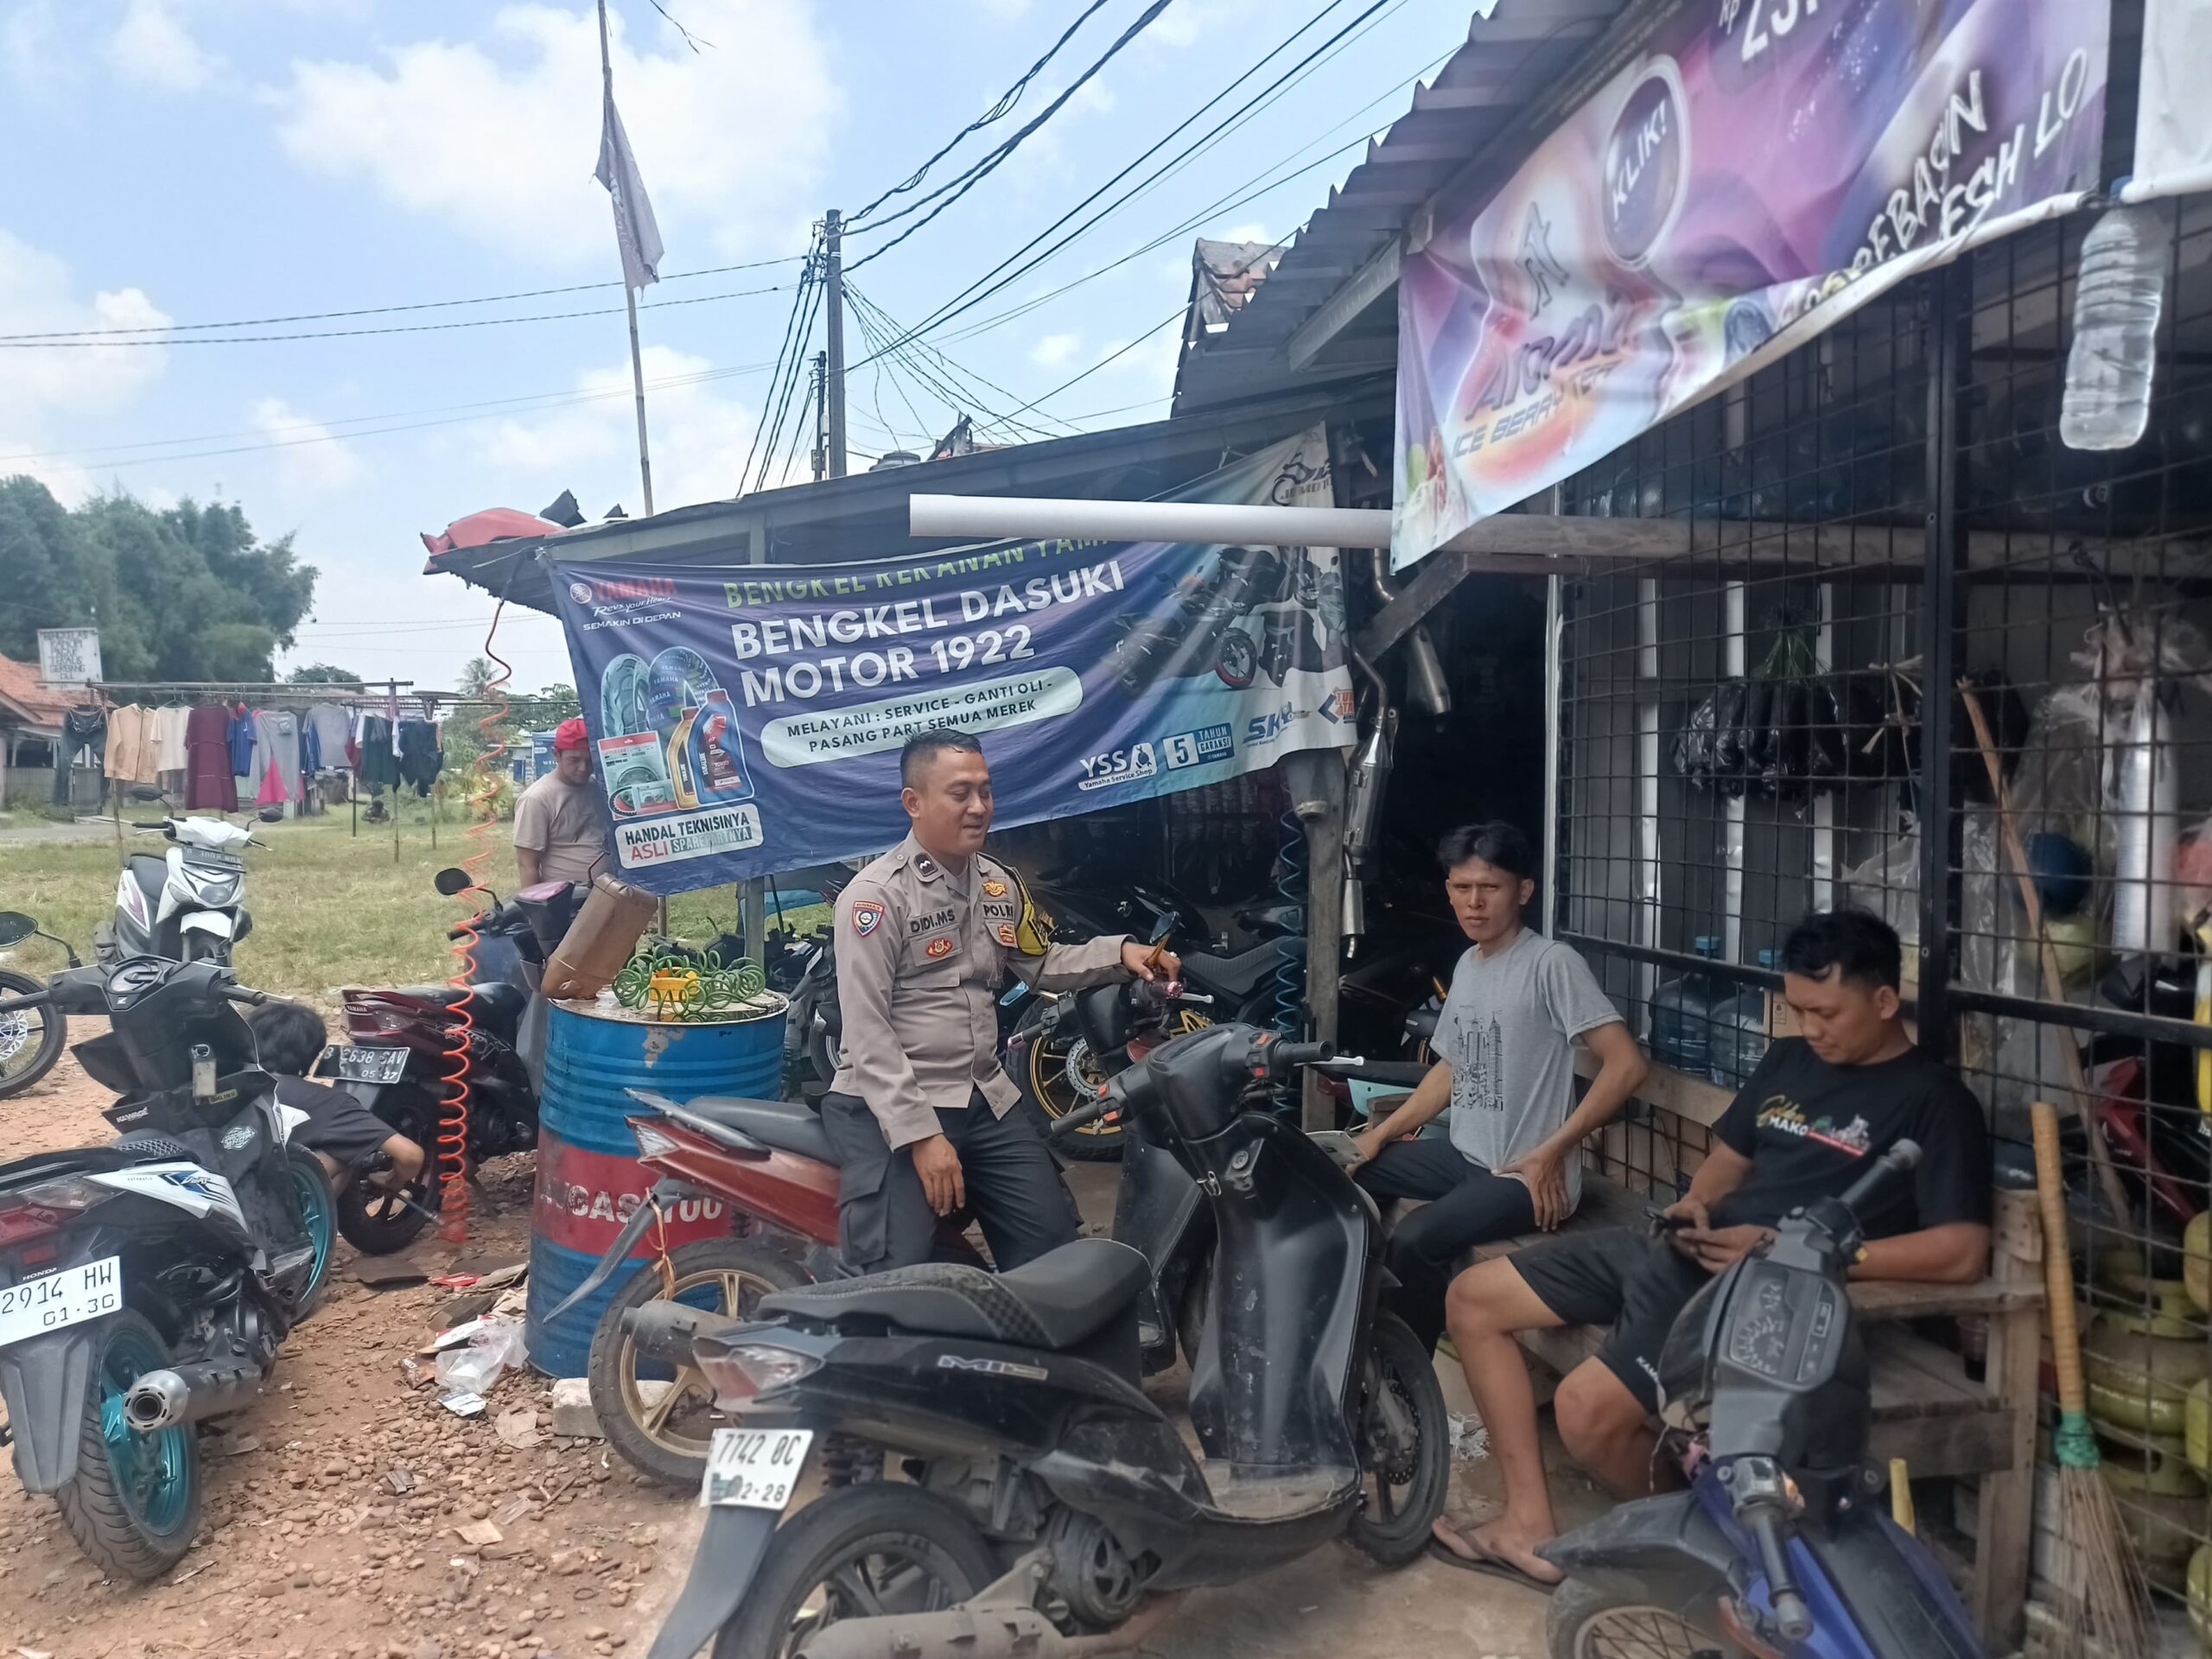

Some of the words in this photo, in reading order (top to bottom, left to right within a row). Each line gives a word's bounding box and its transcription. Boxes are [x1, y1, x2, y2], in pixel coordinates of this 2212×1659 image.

[1612, 99, 1667, 223] KLIK!
[1452, 424, 1487, 460] ICE
[593, 578, 677, 601] YAMAHA
[723, 574, 867, 608] BENGKEL
[583, 619, 631, 631] SEMAKIN
[632, 616, 644, 625] DI
[645, 611, 682, 623] DEPAN
[592, 602, 624, 617] Revs
[626, 601, 645, 613] your
[731, 598, 949, 660] BENGKEL
[959, 560, 1125, 623] DASUKI
[741, 646, 919, 708] MOTOR
[931, 624, 1036, 674] 1922
[787, 712, 870, 737] MELAYANI
[885, 698, 950, 720] SERVICE
[964, 685, 1014, 704] GANTI
[1018, 680, 1043, 695] OLI
[809, 730, 877, 753] PASANG
[883, 721, 922, 740] PART
[928, 711, 982, 731] SEMUA
[987, 699, 1037, 719] MEREK
[1198, 726, 1227, 741] TAHUN
[1173, 738, 1189, 764] 5
[1200, 739, 1230, 753] GARANSI
[1084, 779, 1110, 788] Yamaha
[1111, 772, 1135, 783] Service
[1135, 768, 1153, 778] Shop
[625, 823, 676, 846] HANDAL
[677, 812, 750, 836] TEKNISINYA
[631, 841, 669, 861] ASLI
[982, 905, 1014, 918] POLRI
[2, 1277, 63, 1314] 2914
[85, 1262, 111, 1290] HW
[22, 1268, 57, 1281] HONDA
[717, 1433, 766, 1465] 7742
